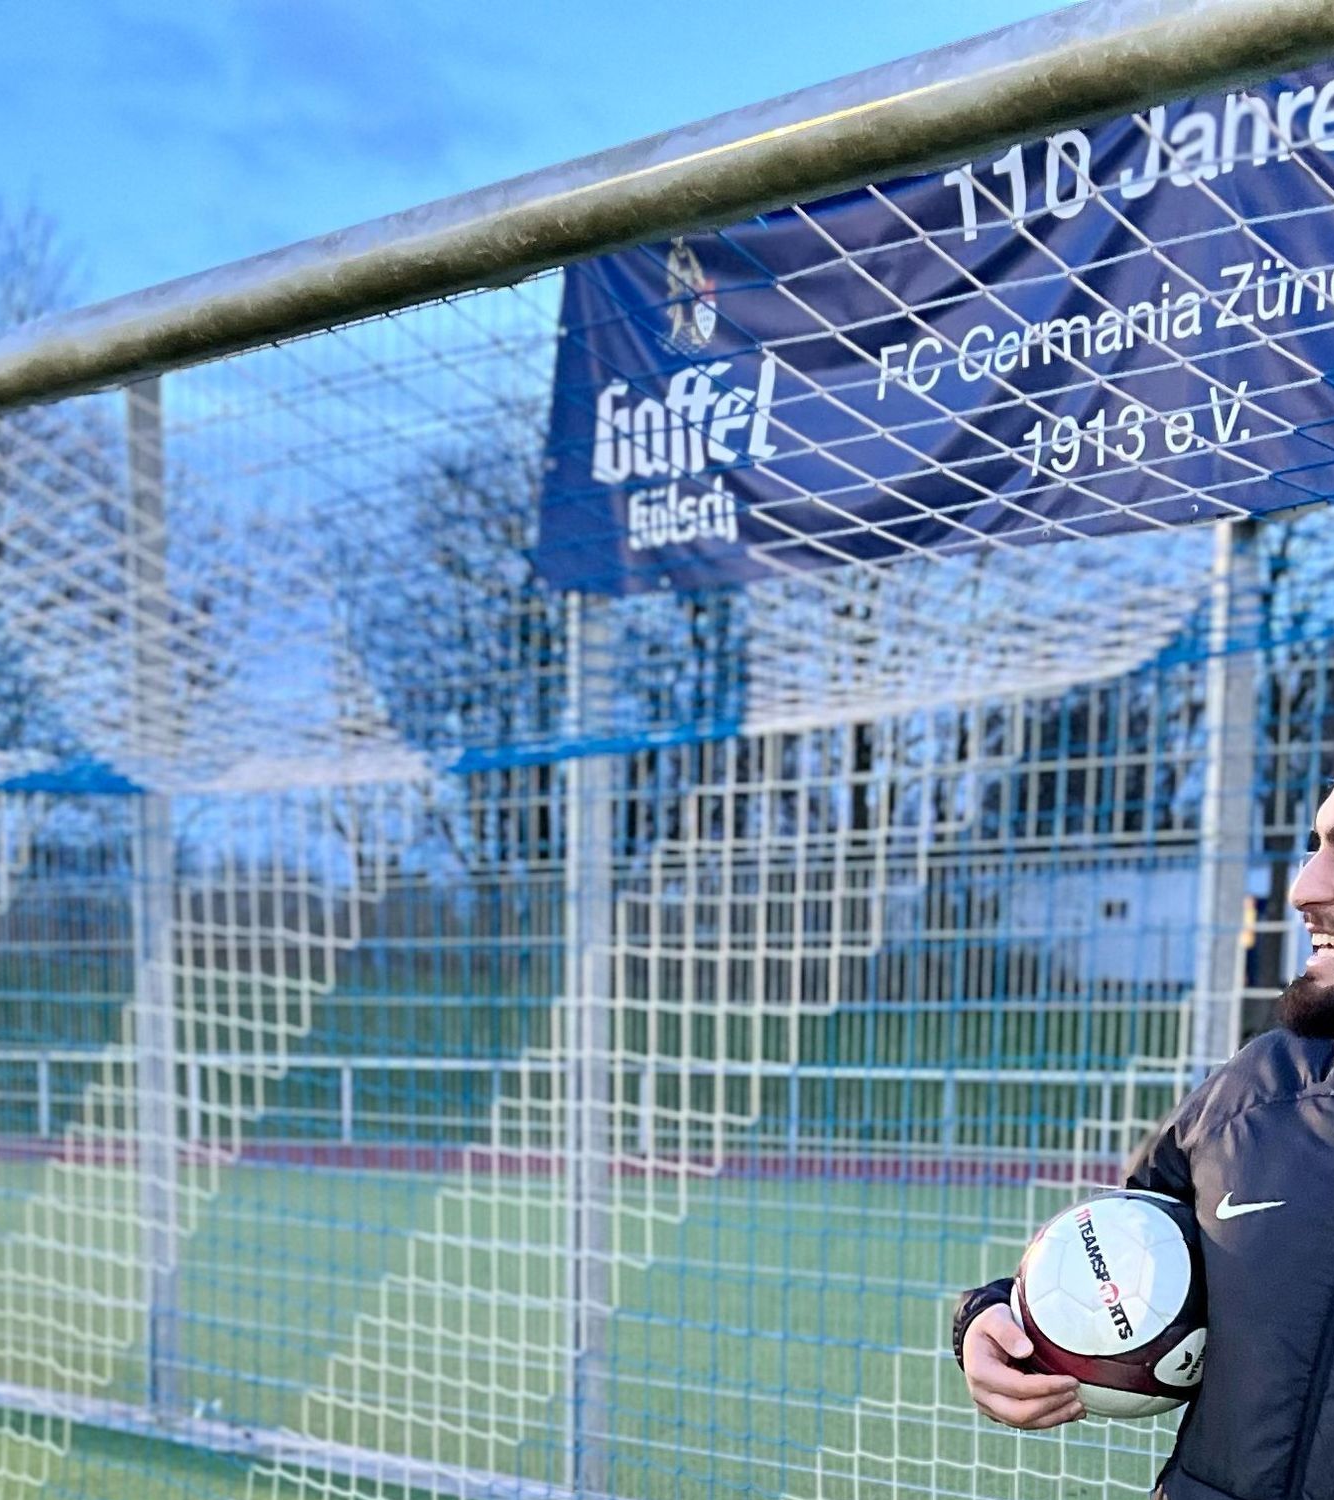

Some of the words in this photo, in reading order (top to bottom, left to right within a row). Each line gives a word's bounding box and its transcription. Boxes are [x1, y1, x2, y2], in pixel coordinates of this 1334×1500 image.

[944, 127, 1091, 242] 110
[877, 337, 942, 400] FC
[957, 282, 1202, 382] Germania
[1022, 402, 1147, 477] 1913
[1165, 380, 1251, 454] e.V.
